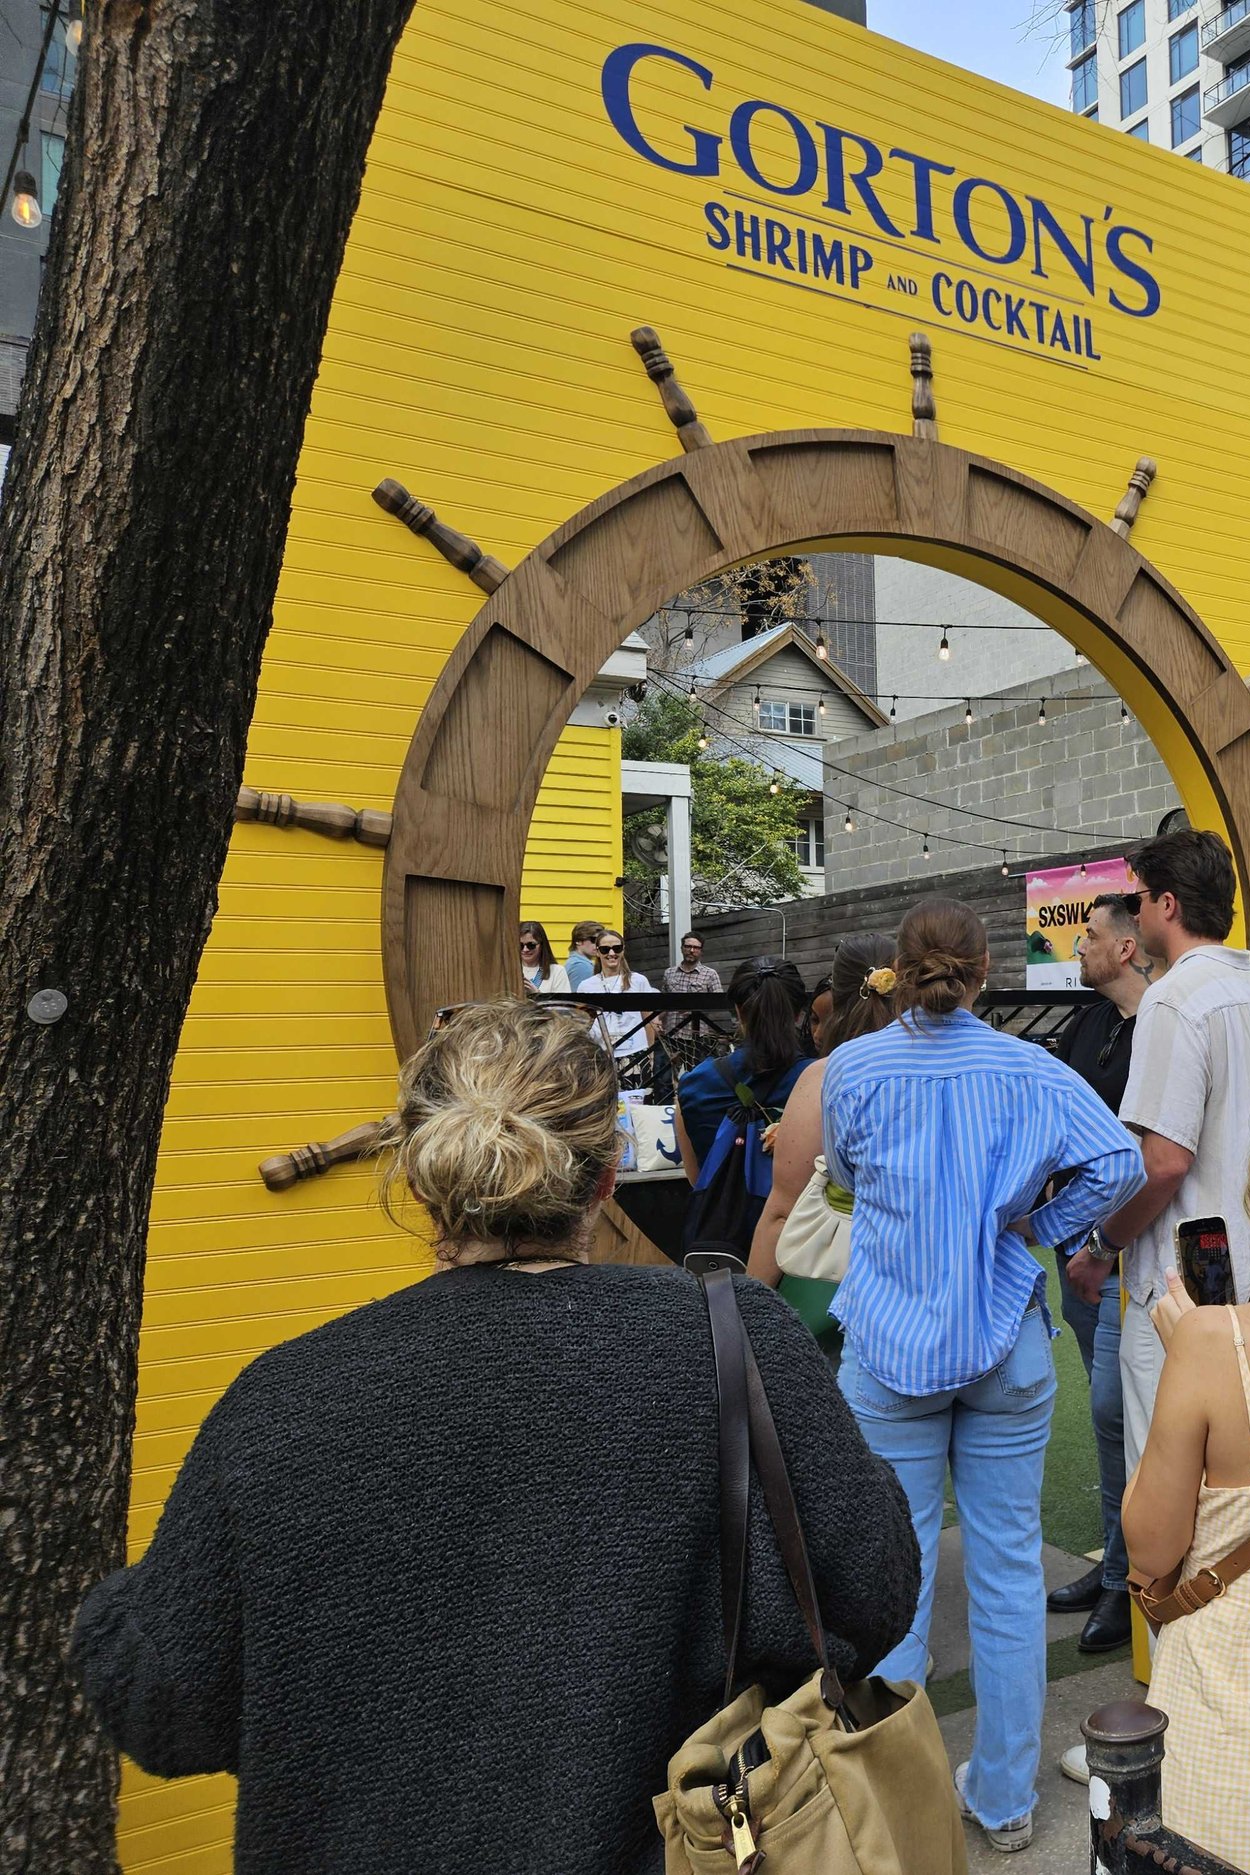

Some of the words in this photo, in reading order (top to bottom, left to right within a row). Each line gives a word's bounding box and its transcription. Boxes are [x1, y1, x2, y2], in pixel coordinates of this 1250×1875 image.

[601, 43, 1160, 318] GORTON'S
[703, 201, 873, 290] SHRIMP
[887, 274, 917, 297] AND
[932, 272, 1101, 361] COCKTAIL
[1038, 902, 1080, 928] SXSW
